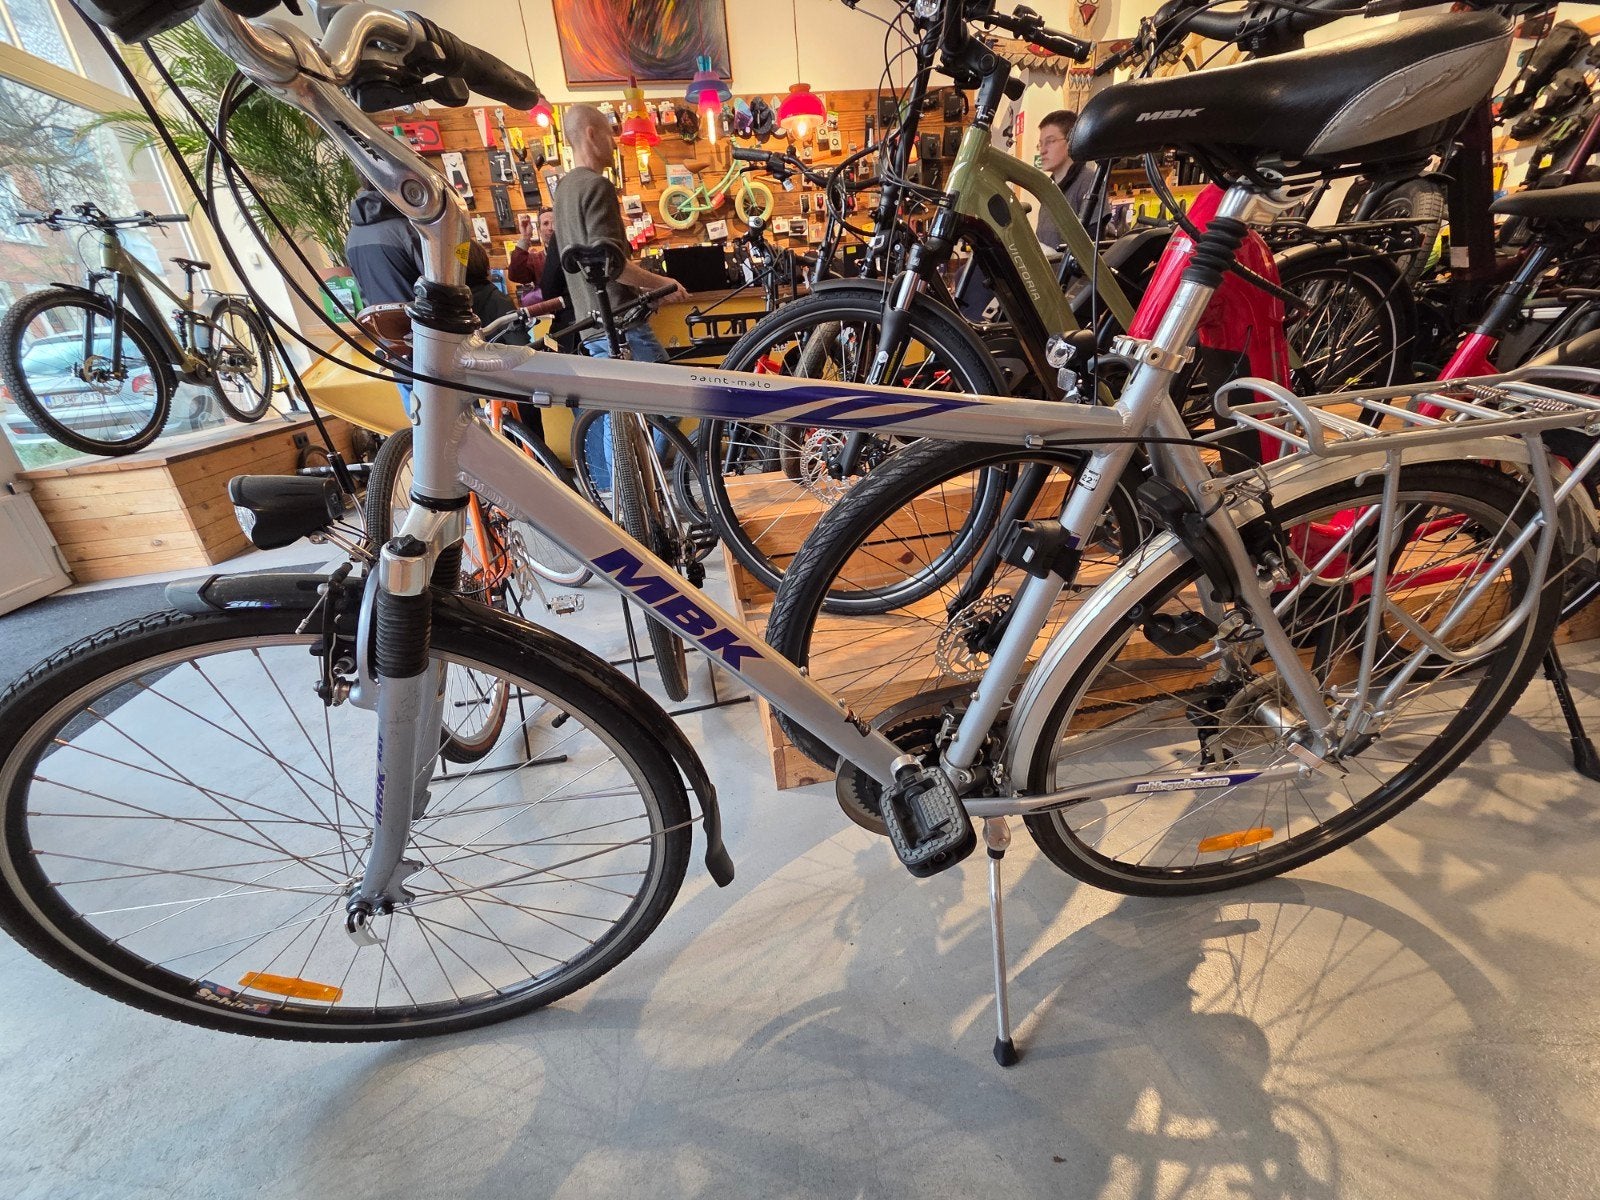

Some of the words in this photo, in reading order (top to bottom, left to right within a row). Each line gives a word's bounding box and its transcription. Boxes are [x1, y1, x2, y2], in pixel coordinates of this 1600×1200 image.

[333, 120, 385, 162] MBK
[1135, 107, 1206, 122] MBK
[1008, 243, 1041, 301] VICTORIA
[590, 547, 765, 672] MBK
[375, 766, 386, 826] MBK
